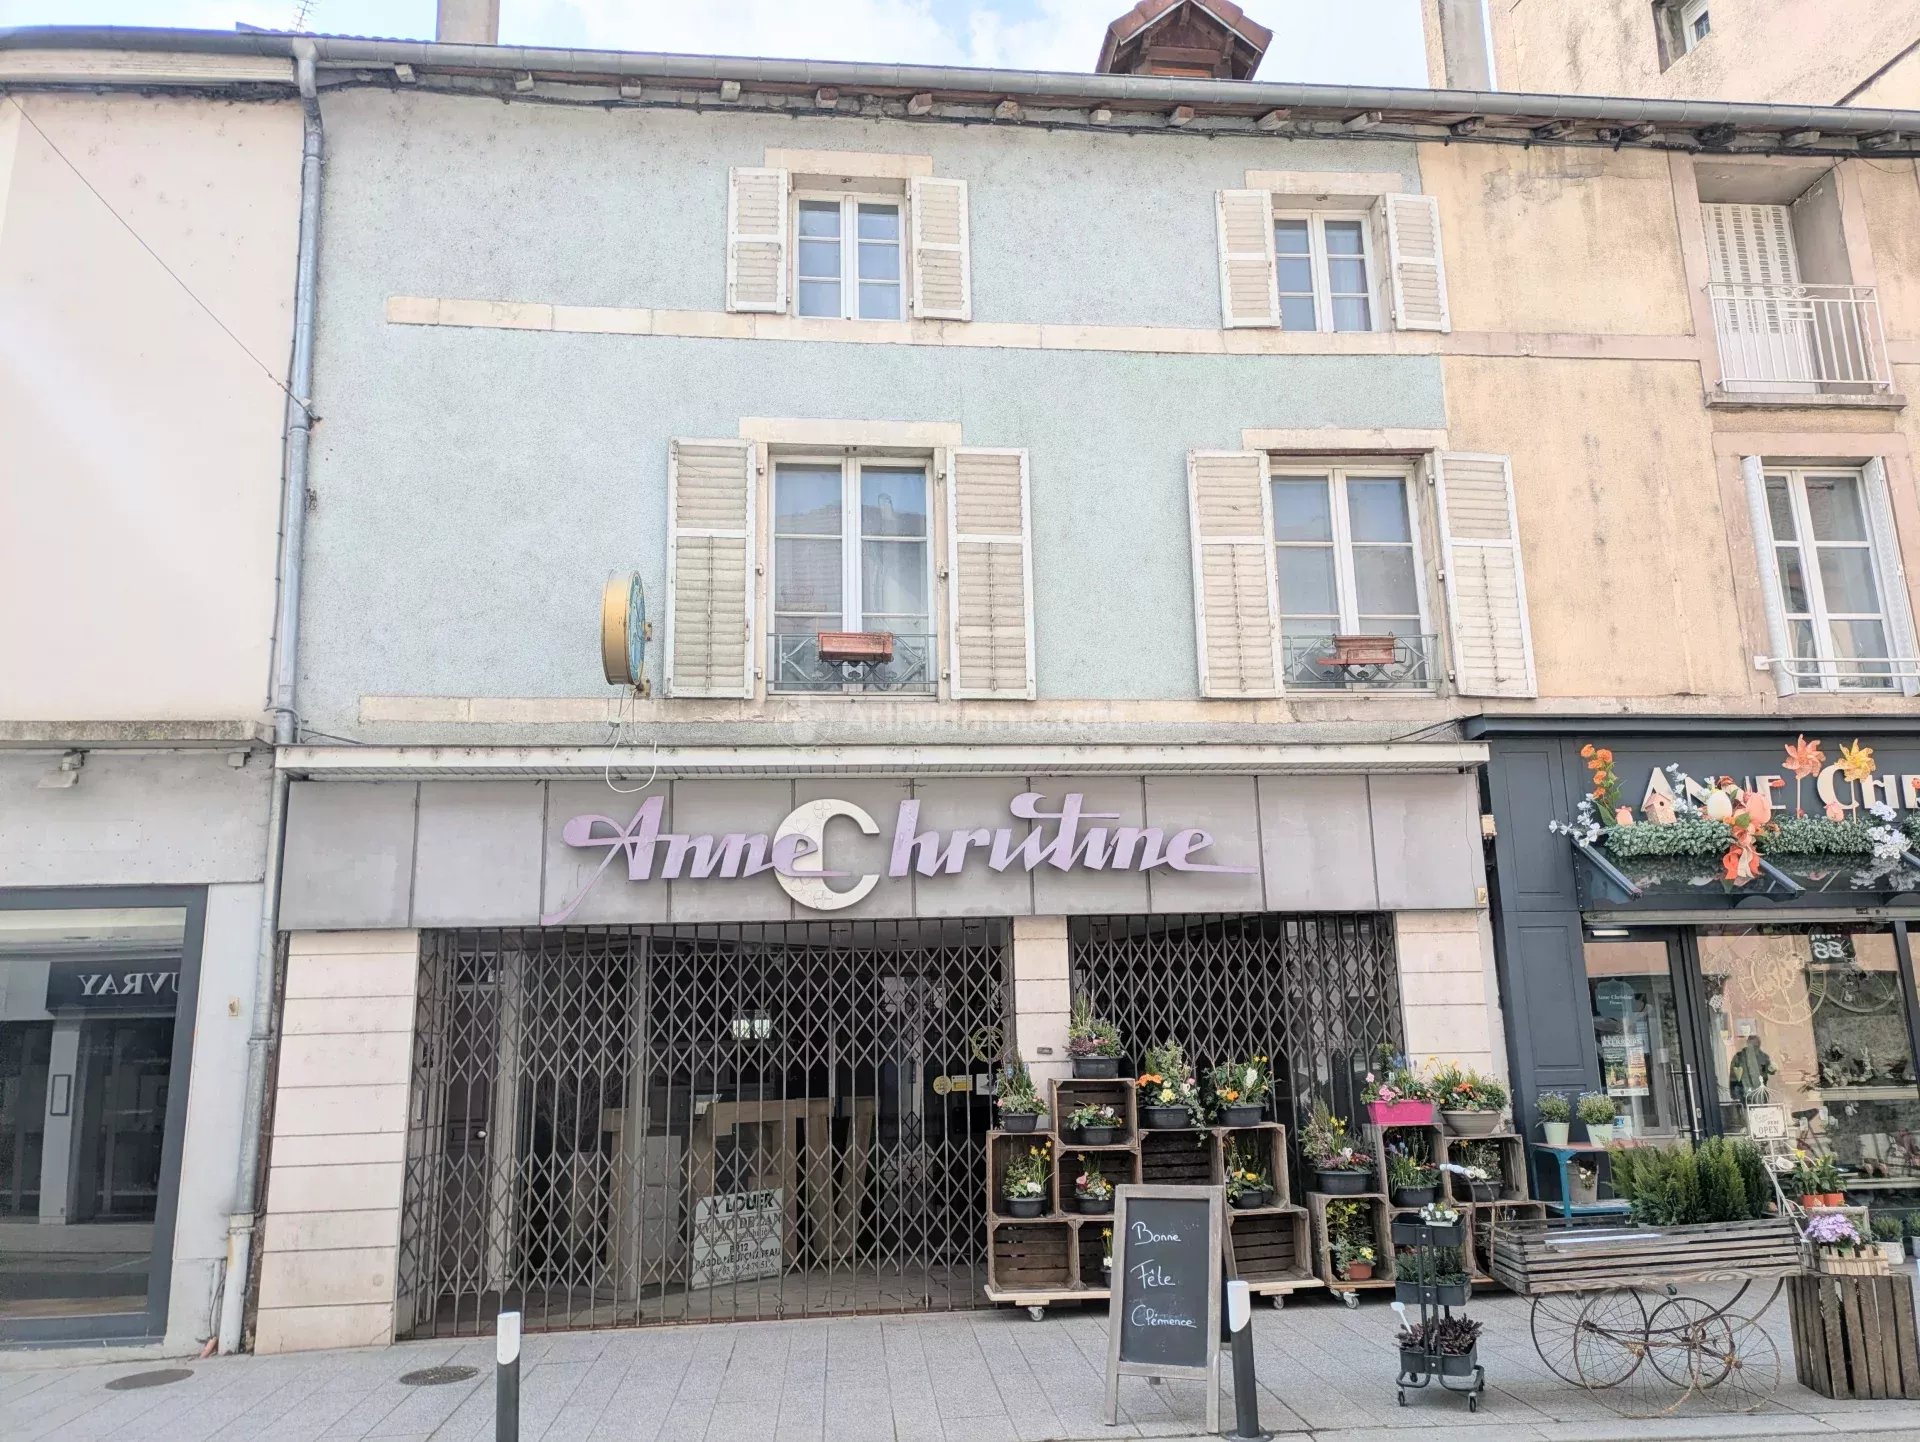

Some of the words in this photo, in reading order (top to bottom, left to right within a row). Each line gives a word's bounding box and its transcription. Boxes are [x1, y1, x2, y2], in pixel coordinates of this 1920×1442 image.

[541, 796, 850, 926] Anne
[1758, 1126, 1779, 1134] OPEN
[725, 1193, 774, 1213] LOUER
[1131, 1221, 1182, 1246] Bonne
[1130, 1259, 1176, 1289] Fête
[1131, 1304, 1198, 1328] Clémence
